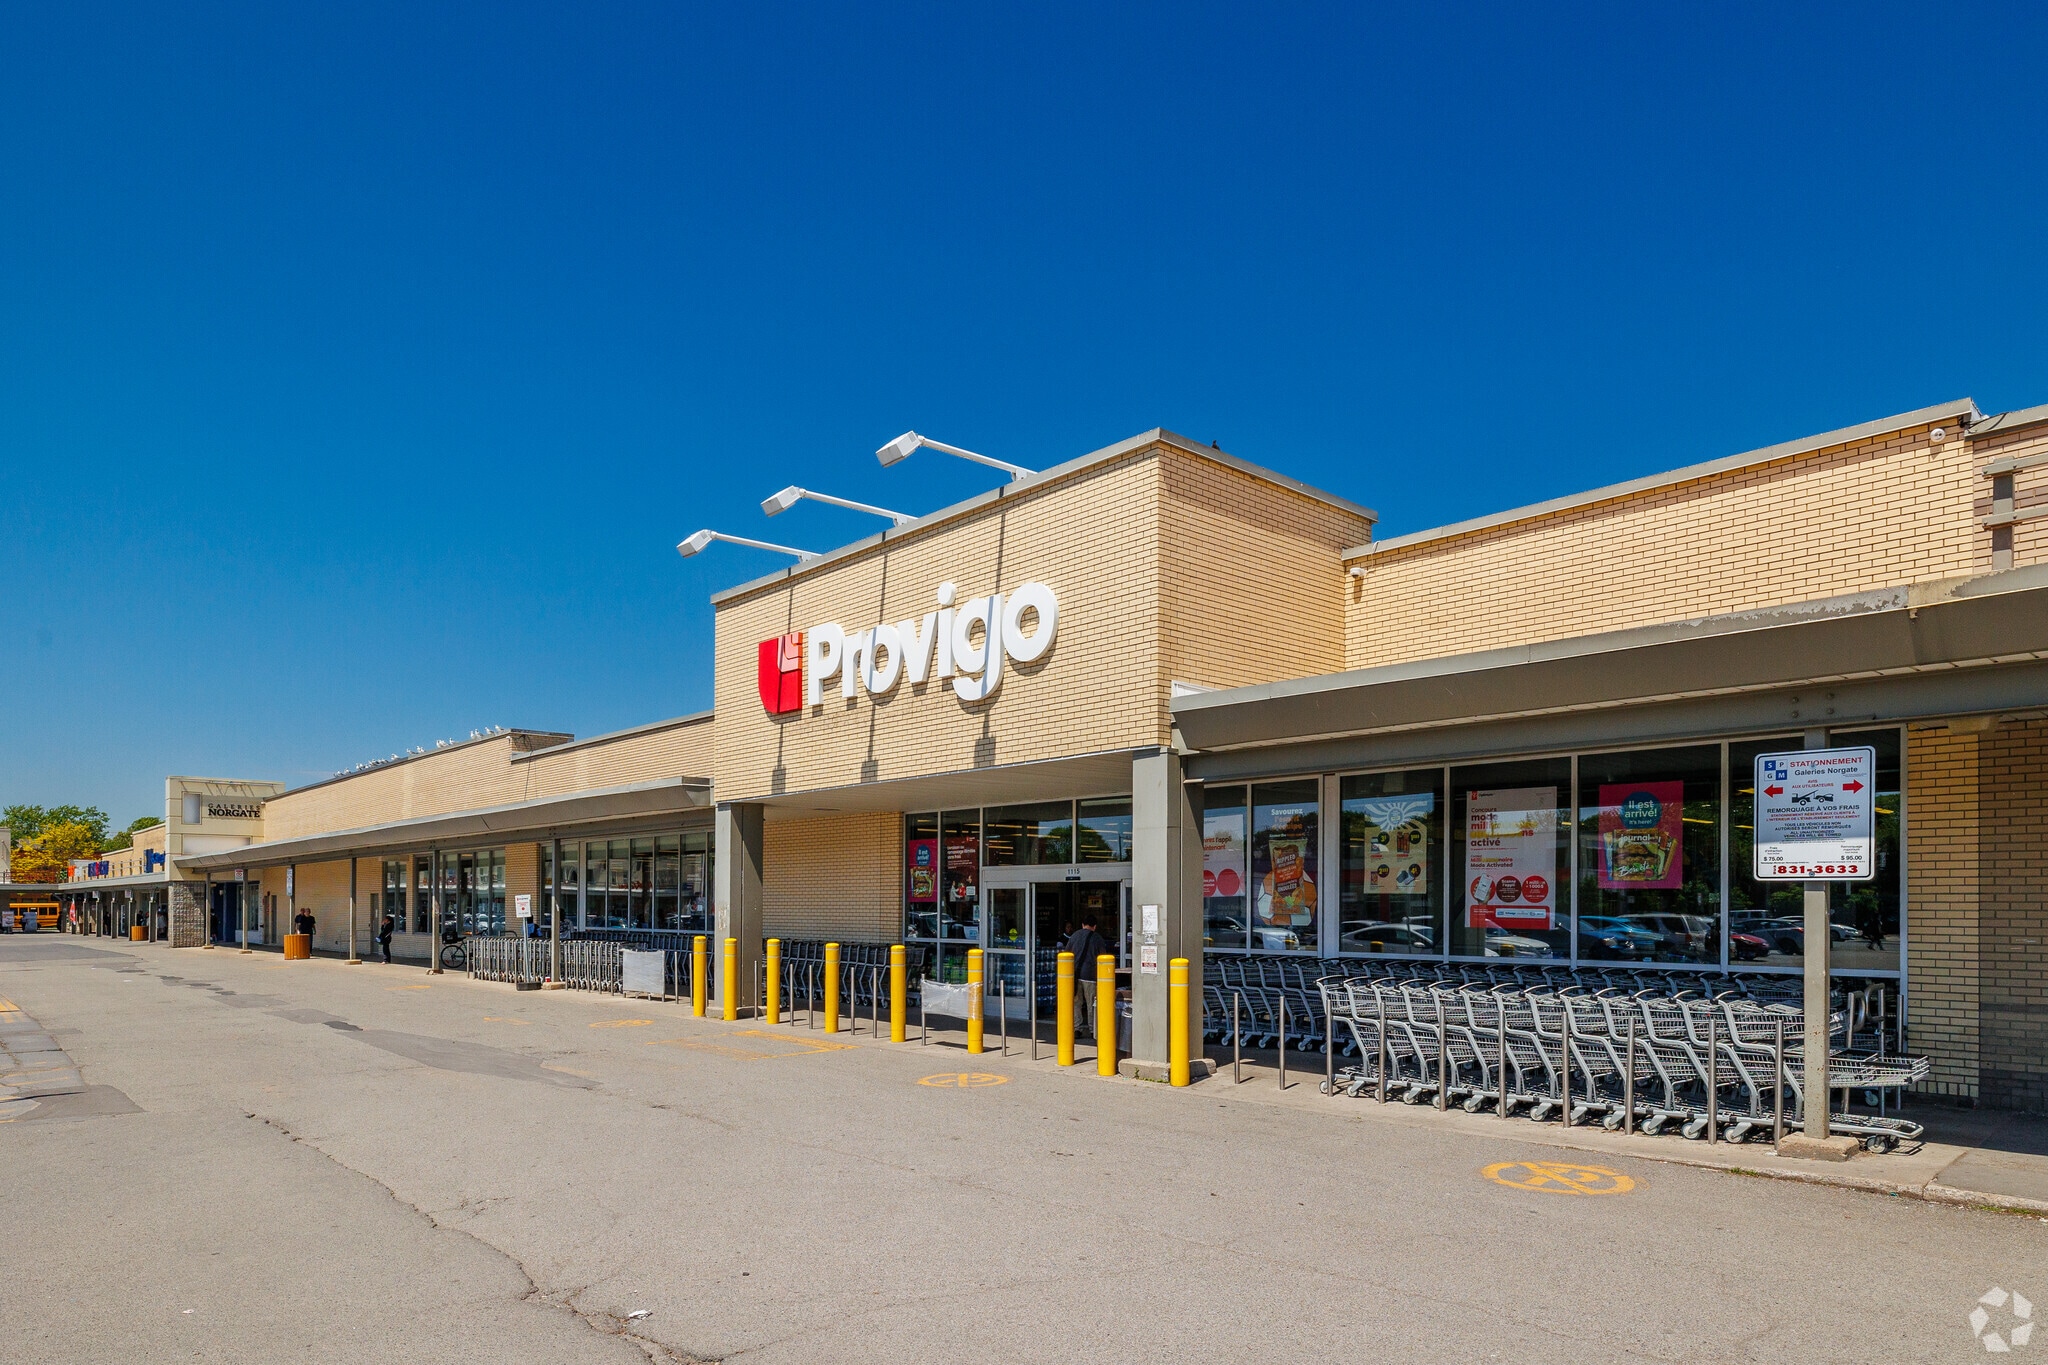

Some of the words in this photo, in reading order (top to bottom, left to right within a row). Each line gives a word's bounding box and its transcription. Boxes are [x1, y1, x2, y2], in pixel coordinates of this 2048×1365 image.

[807, 582, 1059, 705] Provigo
[1790, 757, 1863, 767] STATIONNEMENT
[1638, 800, 1654, 808] est
[208, 809, 260, 817] NORGATE
[1624, 808, 1657, 818] arrivé!
[1471, 838, 1500, 846] activé
[1778, 865, 1858, 874] 831-3633
